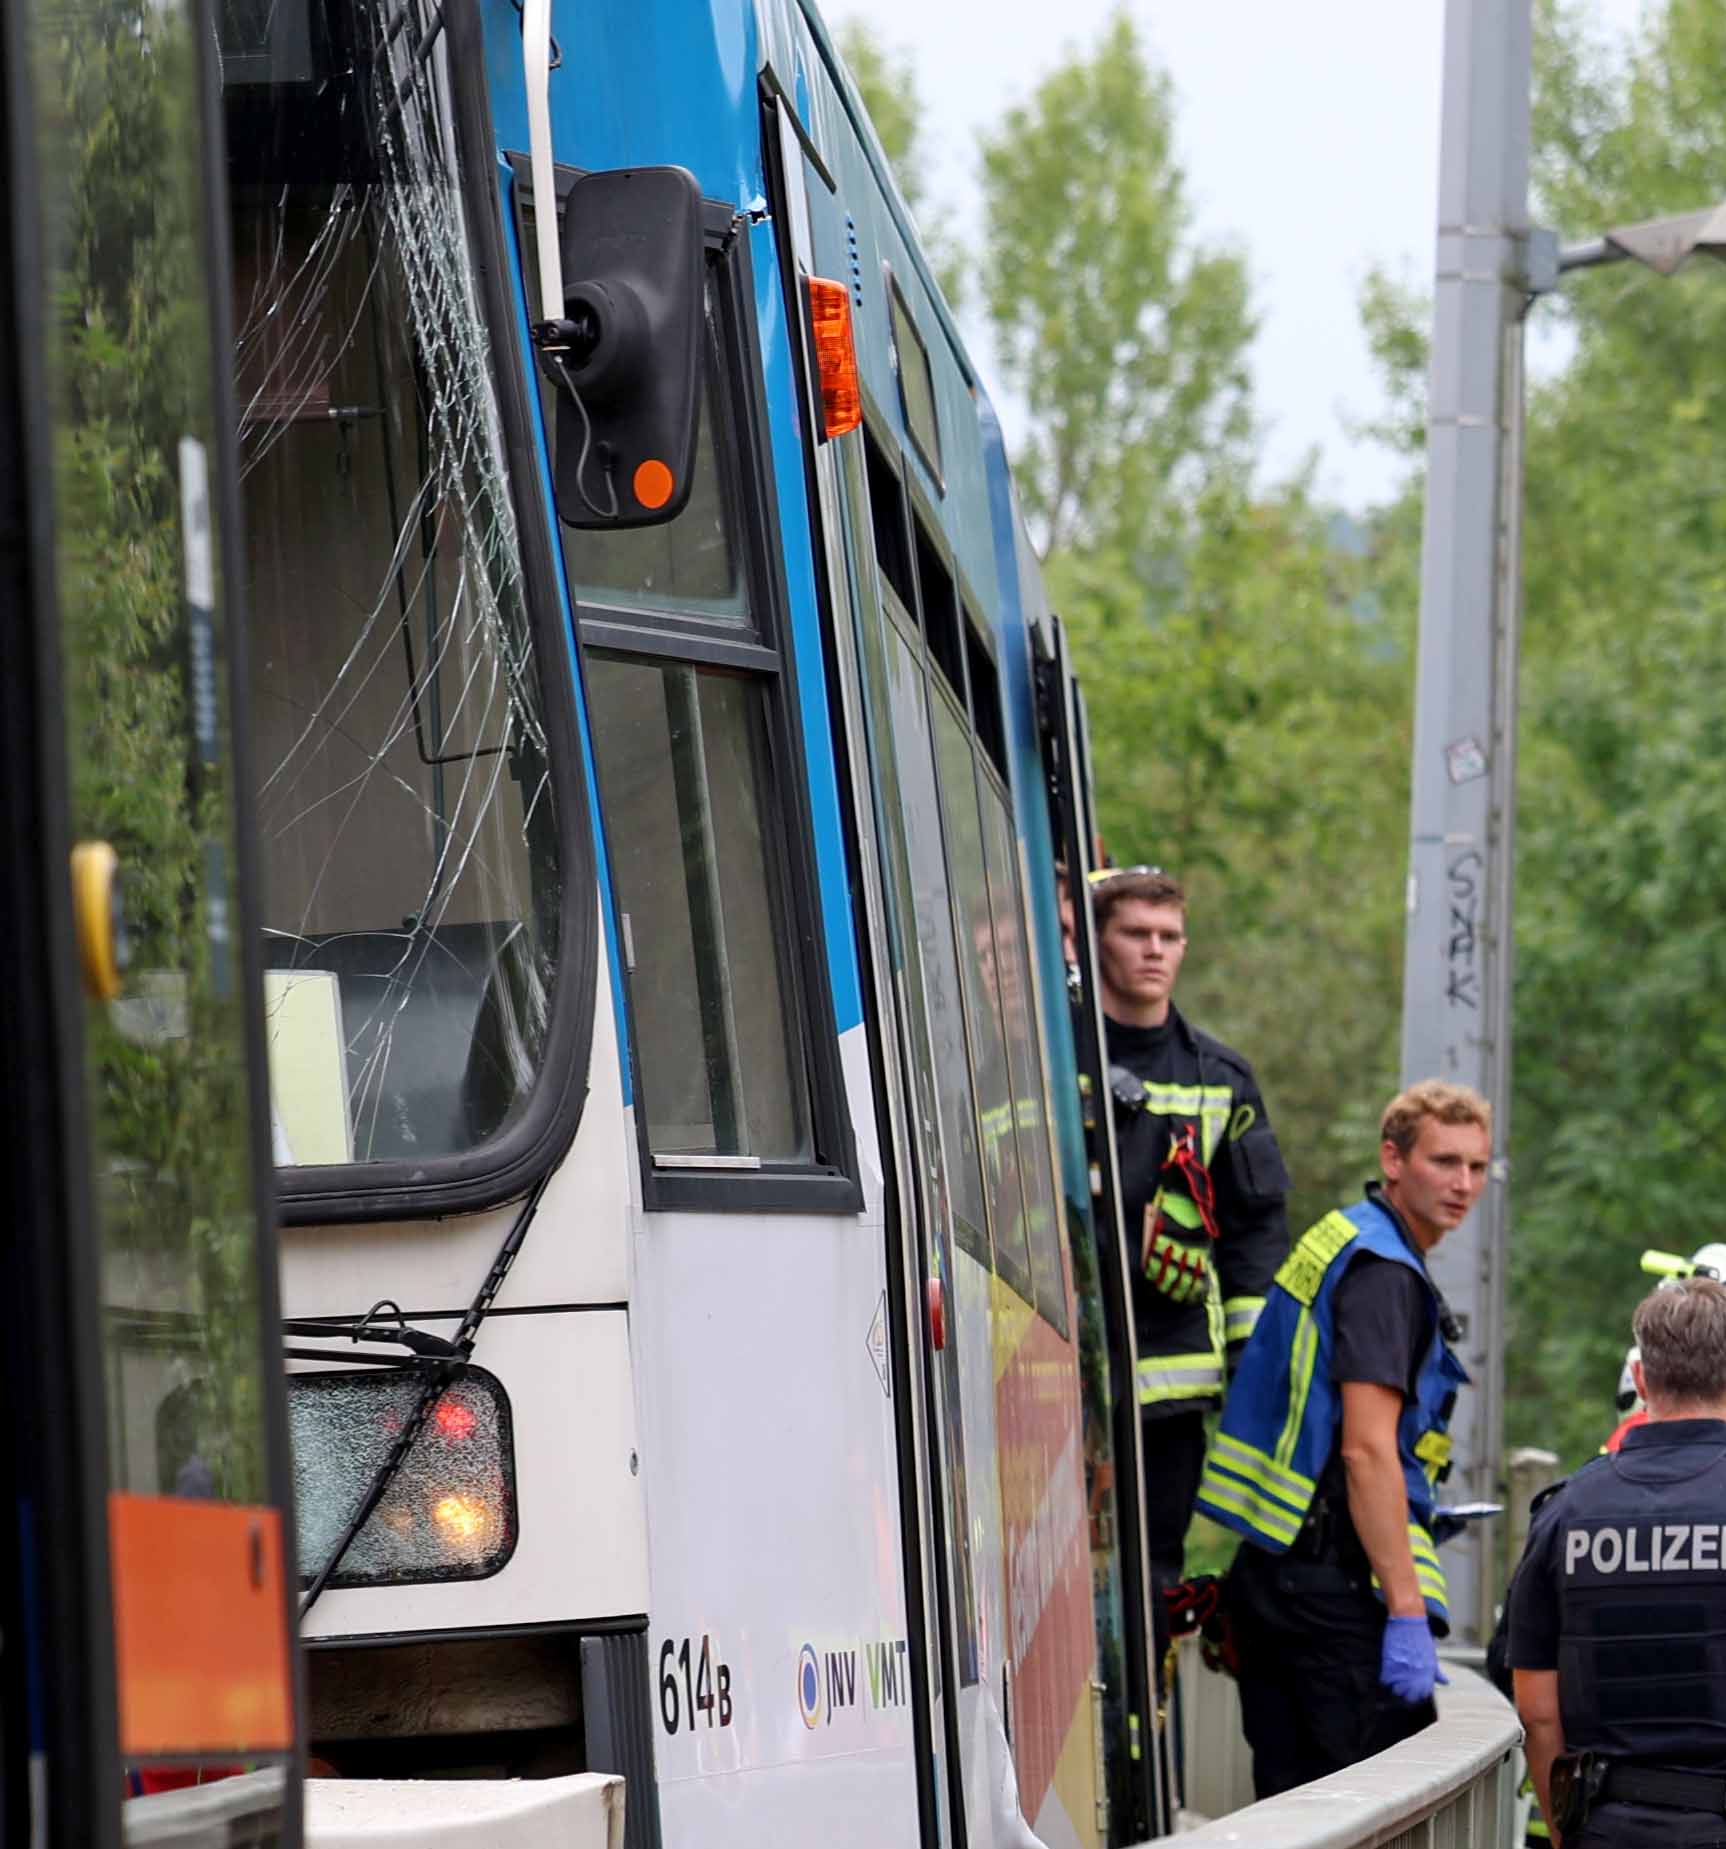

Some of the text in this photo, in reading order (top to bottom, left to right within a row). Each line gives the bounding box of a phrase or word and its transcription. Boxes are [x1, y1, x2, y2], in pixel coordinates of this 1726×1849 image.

[659, 1634, 732, 1735] 614B
[825, 1640, 906, 1726] JNV VMT
